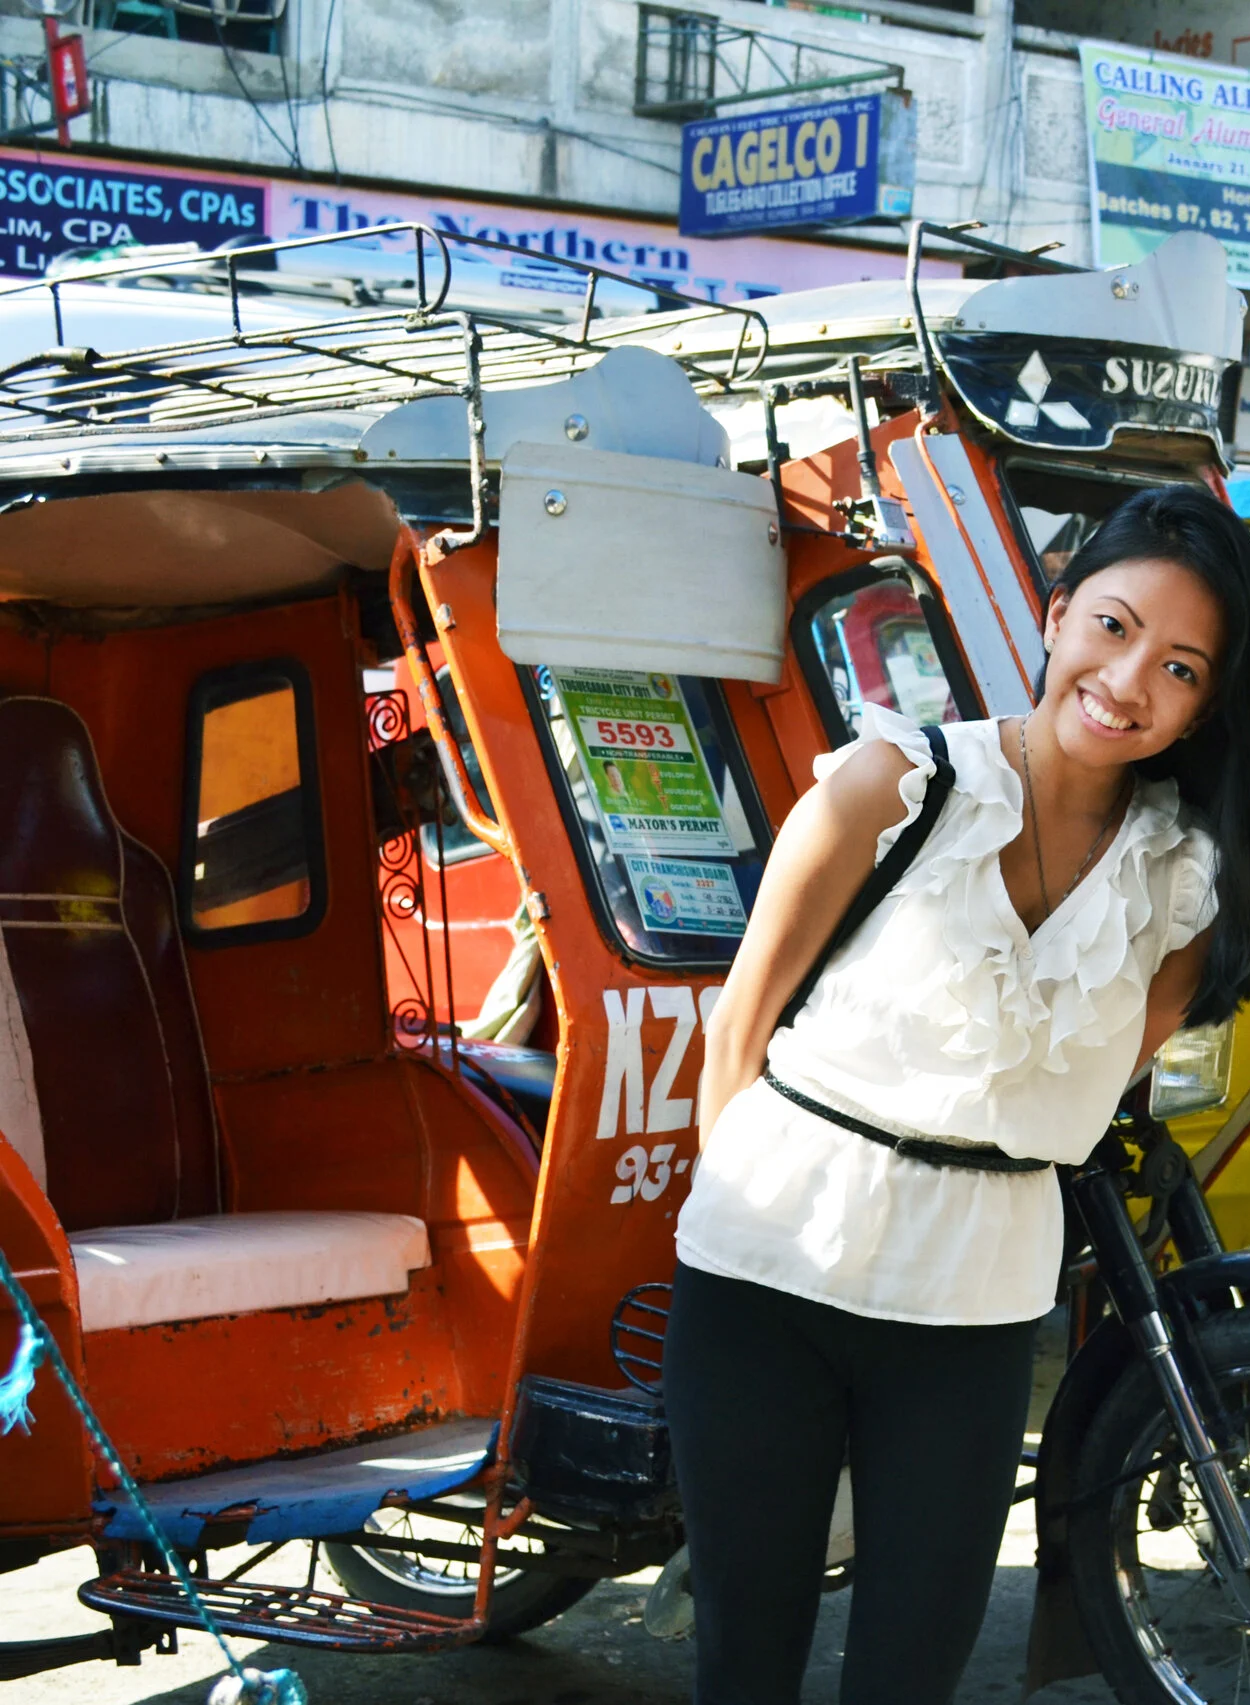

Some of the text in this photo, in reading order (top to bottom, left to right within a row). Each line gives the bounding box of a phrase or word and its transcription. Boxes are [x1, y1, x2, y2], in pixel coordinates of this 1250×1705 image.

[1094, 61, 1204, 102] CALLING
[1097, 98, 1186, 139] General
[692, 113, 869, 192] CAGELCO I
[1167, 152, 1224, 173] January
[179, 189, 257, 228] CPAs
[1098, 190, 1172, 221] Batches
[291, 193, 412, 232] The
[430, 210, 691, 272] Northern
[1102, 356, 1221, 411] SUZUKI
[597, 721, 676, 749] 5593
[628, 817, 720, 833] MAYOR'S PERMIT
[631, 860, 650, 873] CITY
[610, 1143, 703, 1204] 93-
